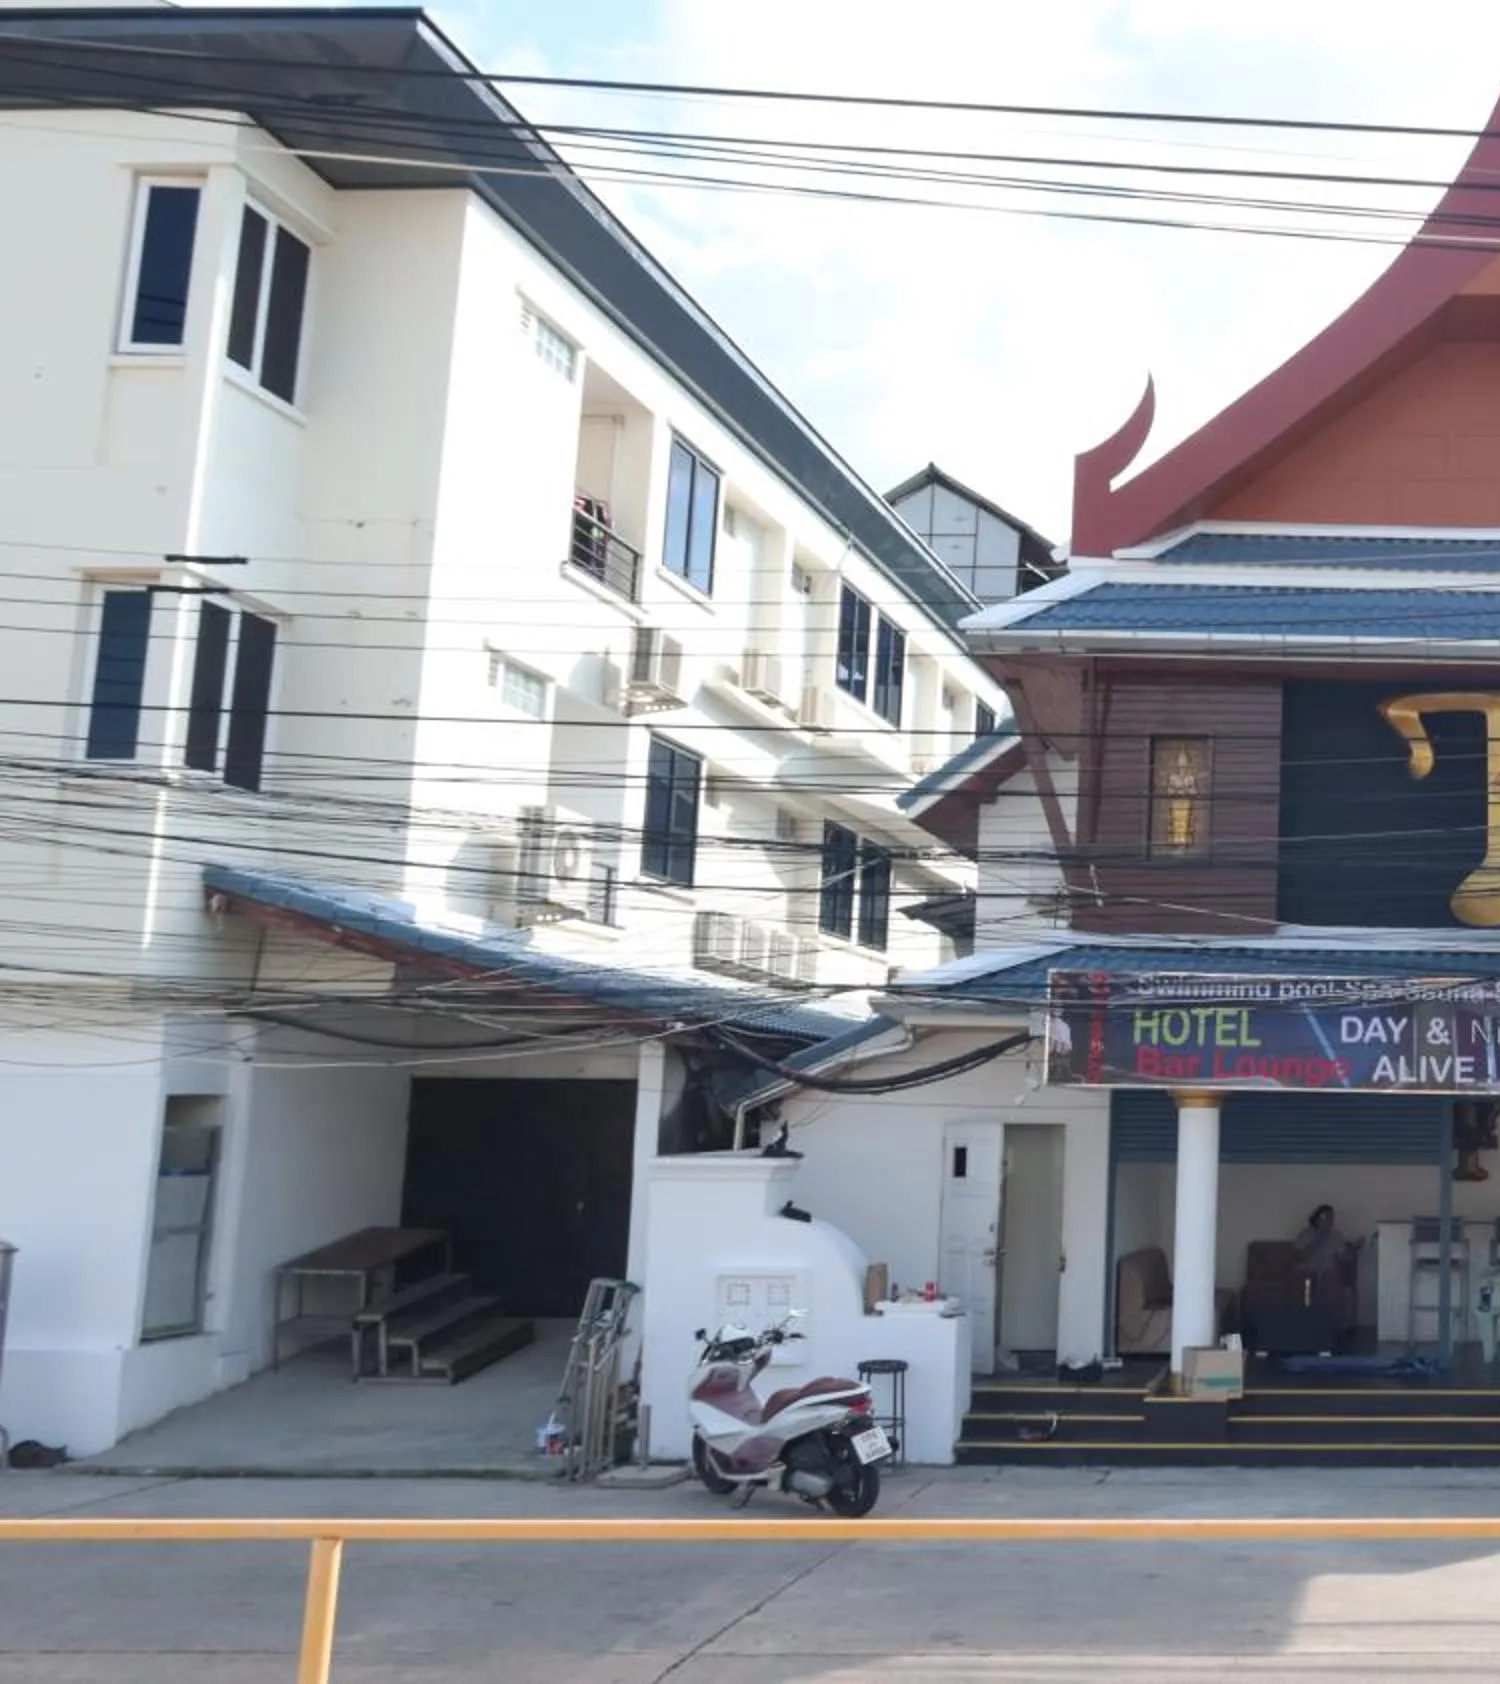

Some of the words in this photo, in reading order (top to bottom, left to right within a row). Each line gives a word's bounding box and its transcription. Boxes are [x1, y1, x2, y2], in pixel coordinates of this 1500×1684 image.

[1133, 1006, 1262, 1047] HOTEL
[1340, 1015, 1408, 1043] DAY
[1426, 1016, 1451, 1046] &
[1136, 1047, 1197, 1077] Bar
[1213, 1050, 1347, 1088] Lounge
[1372, 1055, 1475, 1084] ALIVE
